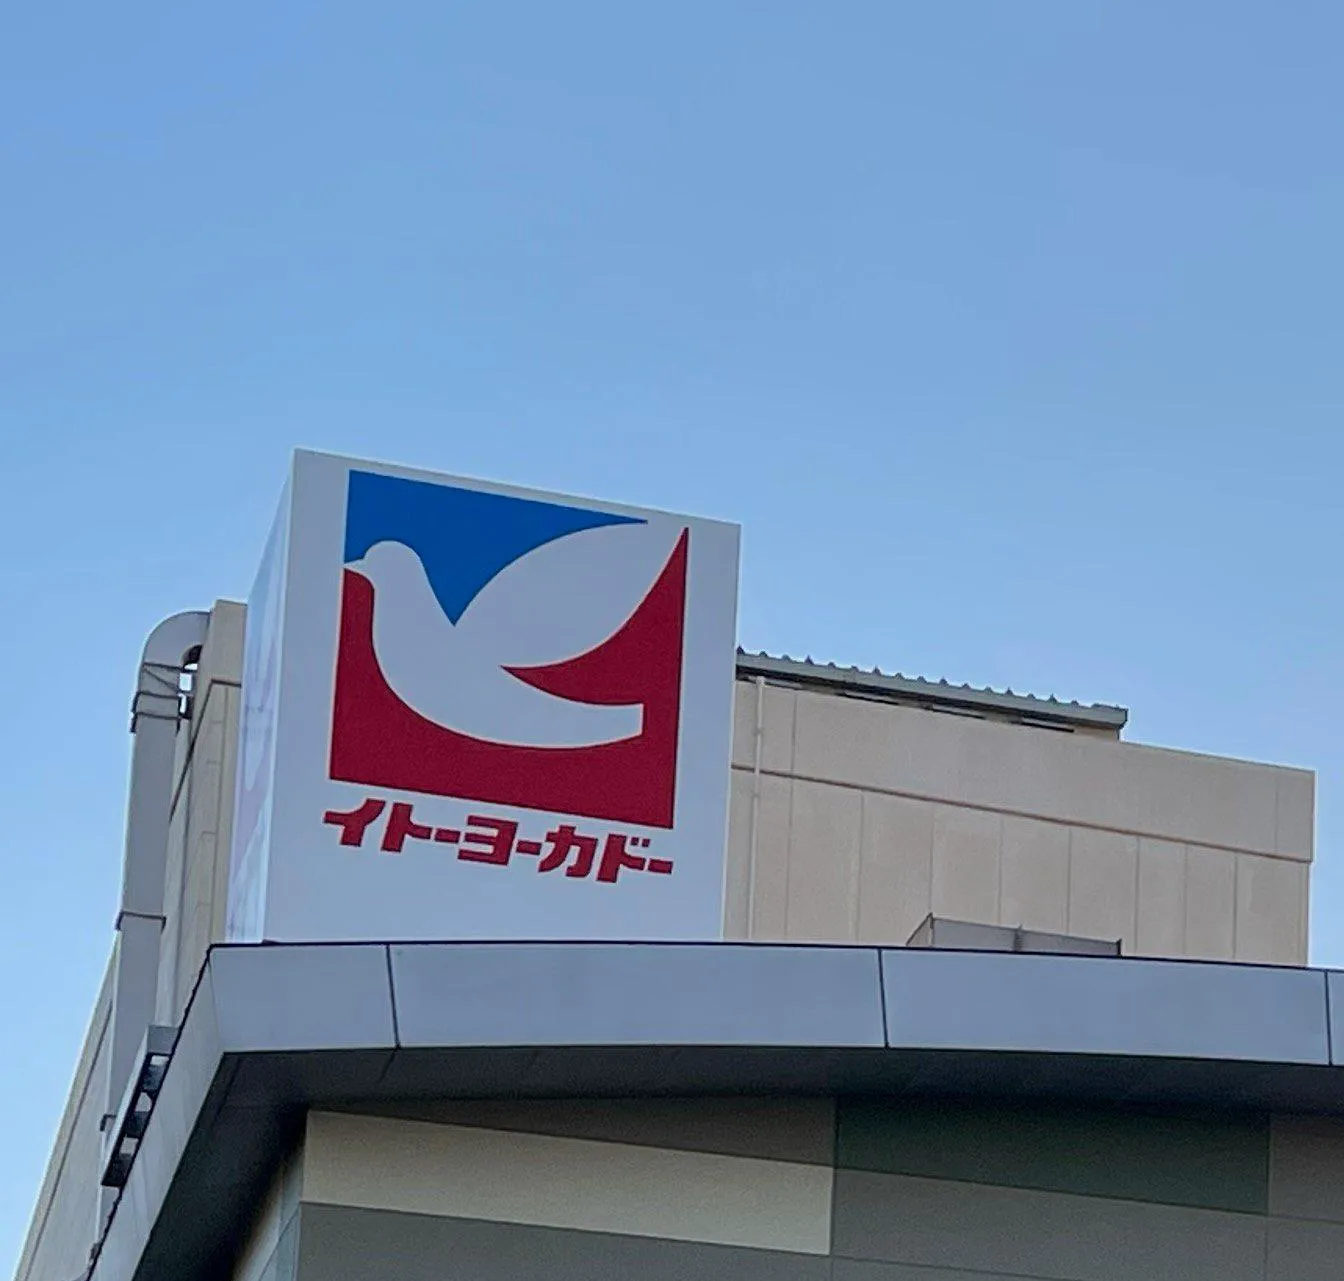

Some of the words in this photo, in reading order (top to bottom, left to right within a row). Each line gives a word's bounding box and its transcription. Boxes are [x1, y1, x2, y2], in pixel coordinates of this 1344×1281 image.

[324, 798, 674, 883] イトーヨーカドー
